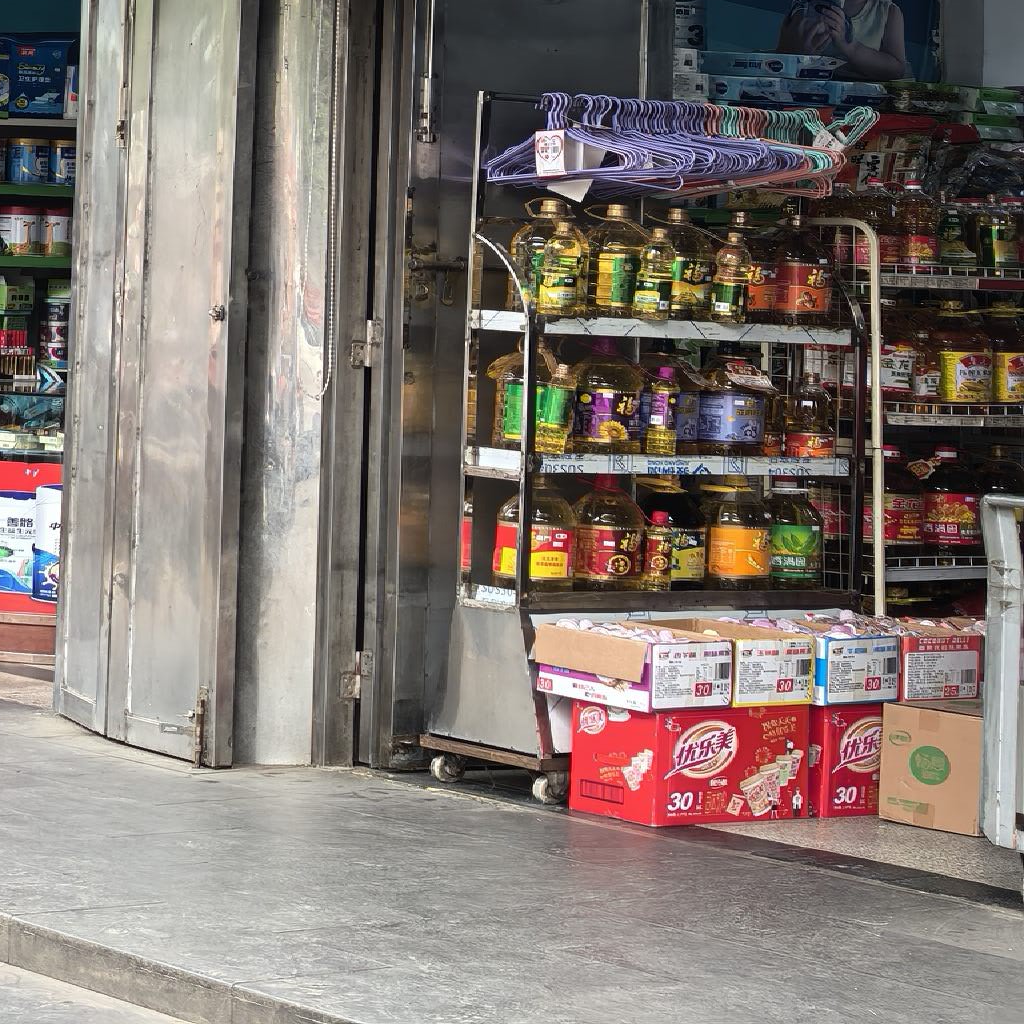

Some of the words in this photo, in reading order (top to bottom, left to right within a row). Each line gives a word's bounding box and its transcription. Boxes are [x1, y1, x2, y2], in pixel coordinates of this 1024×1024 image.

[695, 684, 711, 696] 30
[777, 680, 792, 691] 30
[866, 679, 881, 690] 30
[944, 686, 957, 696] 25
[675, 727, 736, 767] 优乐美
[840, 729, 883, 762] 优乐
[667, 792, 694, 811] 30
[833, 786, 858, 805] 30
